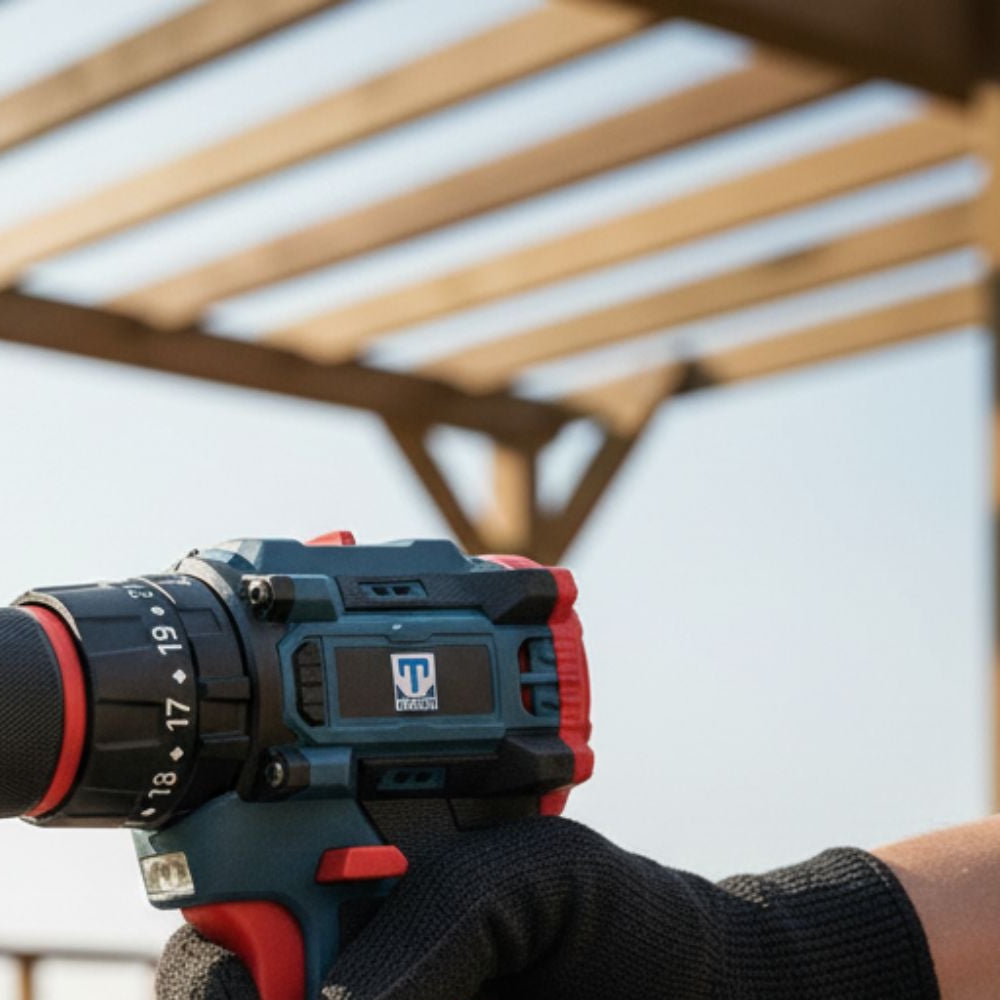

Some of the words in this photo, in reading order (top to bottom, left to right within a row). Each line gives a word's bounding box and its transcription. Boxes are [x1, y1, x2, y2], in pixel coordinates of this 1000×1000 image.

[151, 625, 182, 656] 19
[165, 697, 191, 732] 17
[147, 771, 177, 799] 18
